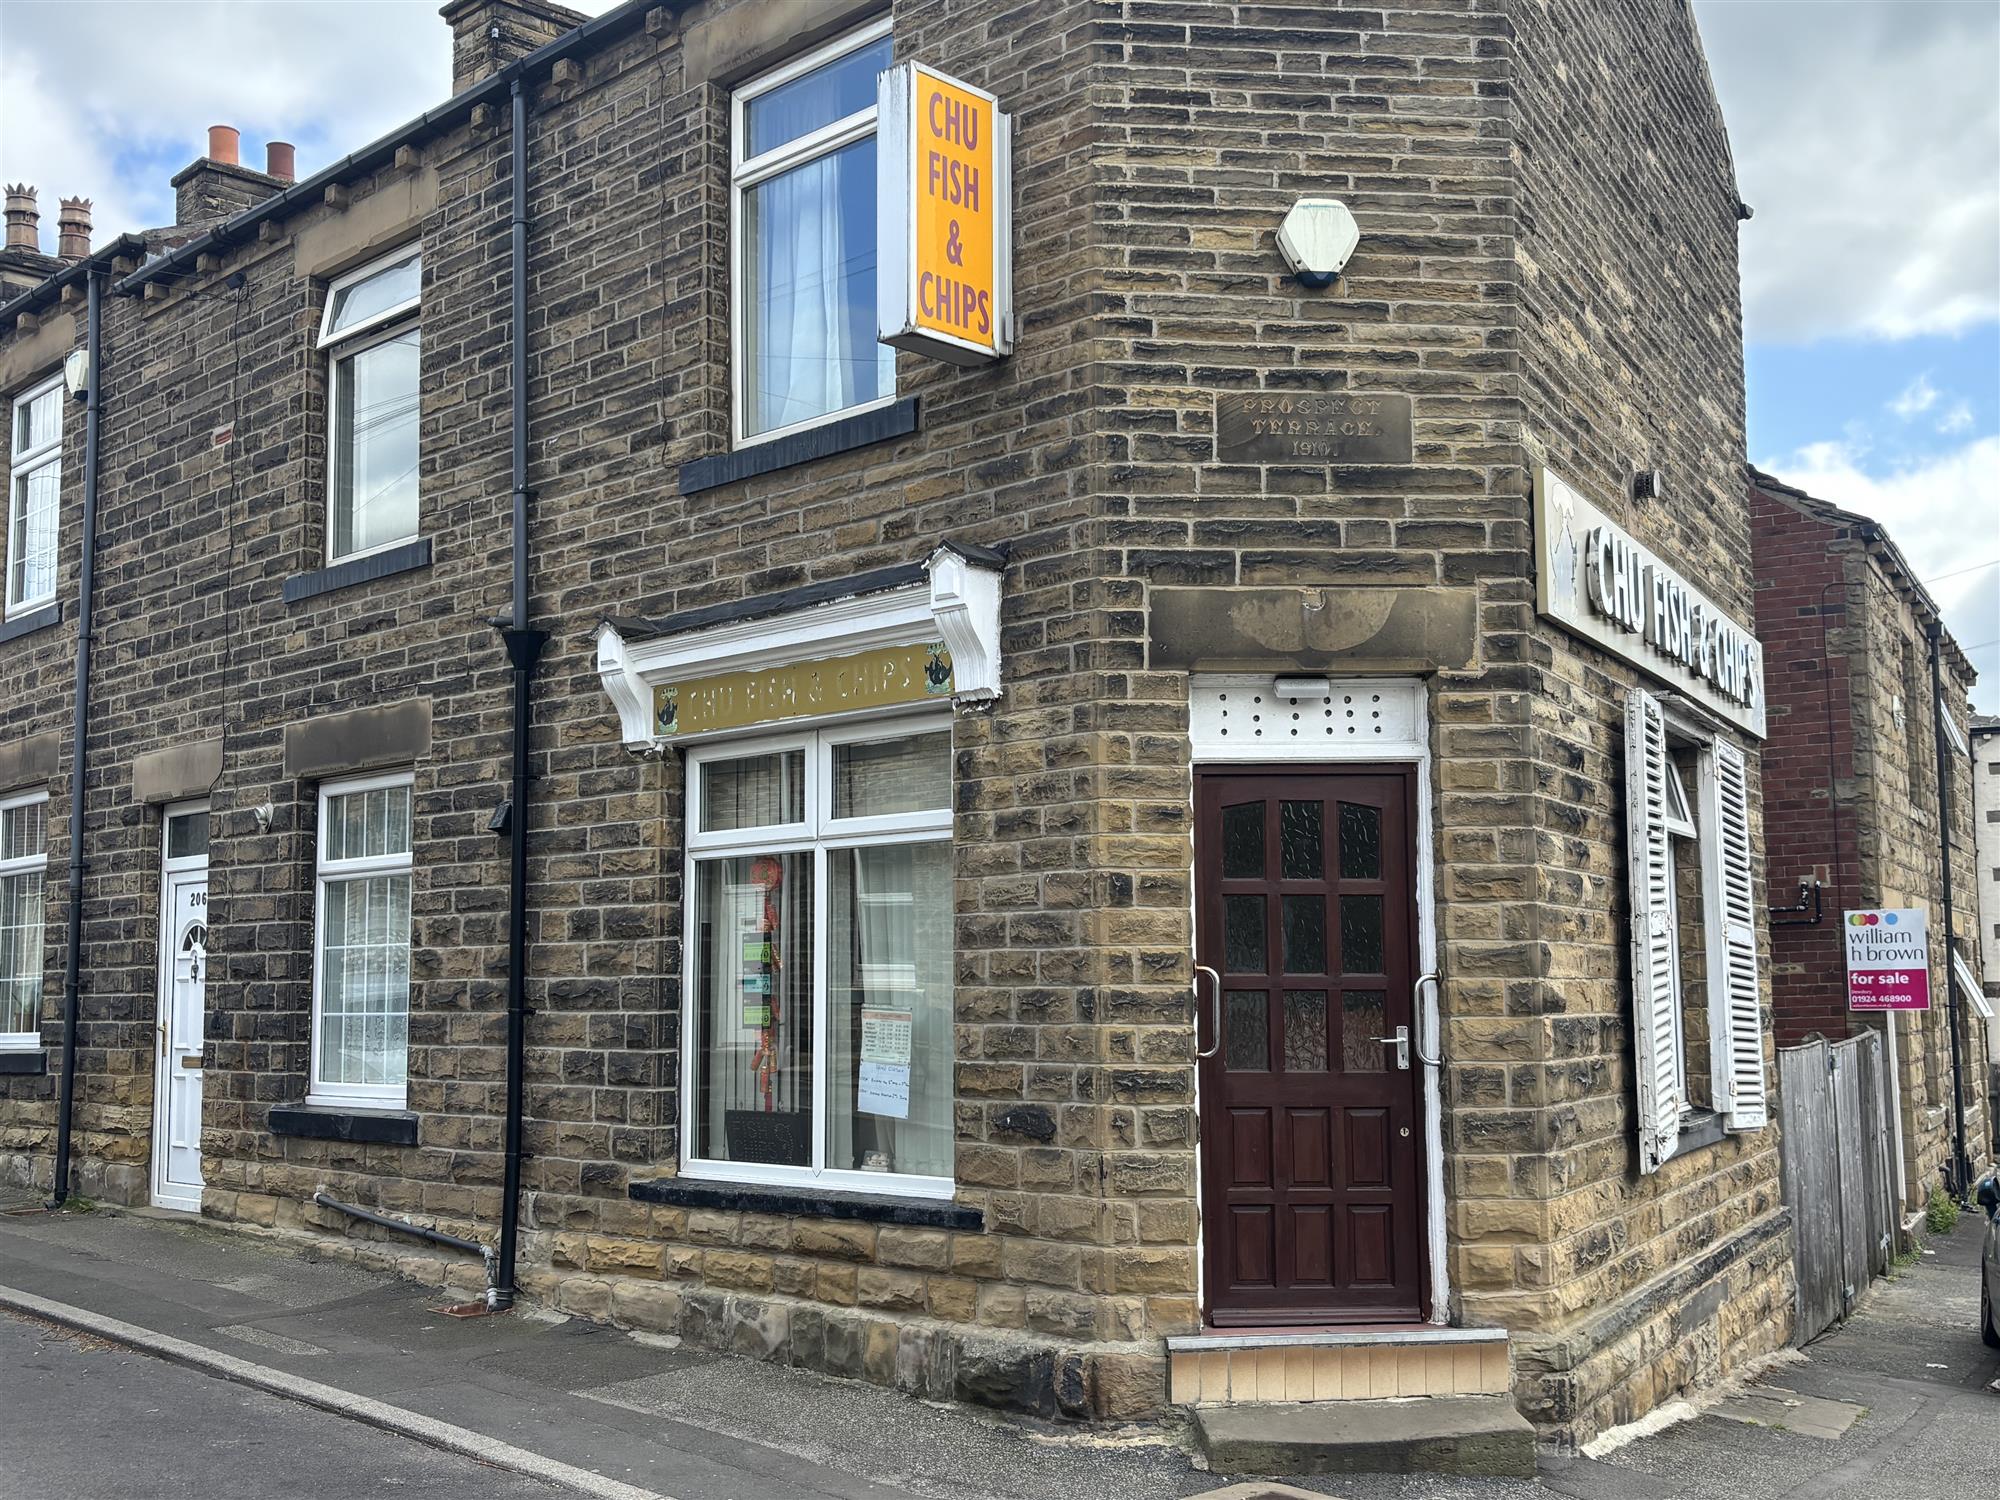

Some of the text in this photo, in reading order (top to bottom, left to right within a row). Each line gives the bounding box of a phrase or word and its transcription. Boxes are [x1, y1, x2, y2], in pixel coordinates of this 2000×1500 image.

[929, 92, 977, 150] CHU
[929, 151, 978, 212] FISH
[946, 219, 963, 267] &
[919, 271, 990, 335] CHIPS
[1241, 399, 1384, 415] PROSPECT
[1589, 526, 1757, 709] CHU FISH & CHIPS
[190, 892, 207, 907] 206
[1849, 928, 1912, 944] william
[1851, 946, 1924, 961] h brown
[1851, 971, 1909, 985] for sale
[1851, 994, 1912, 1003] 01924 468900
